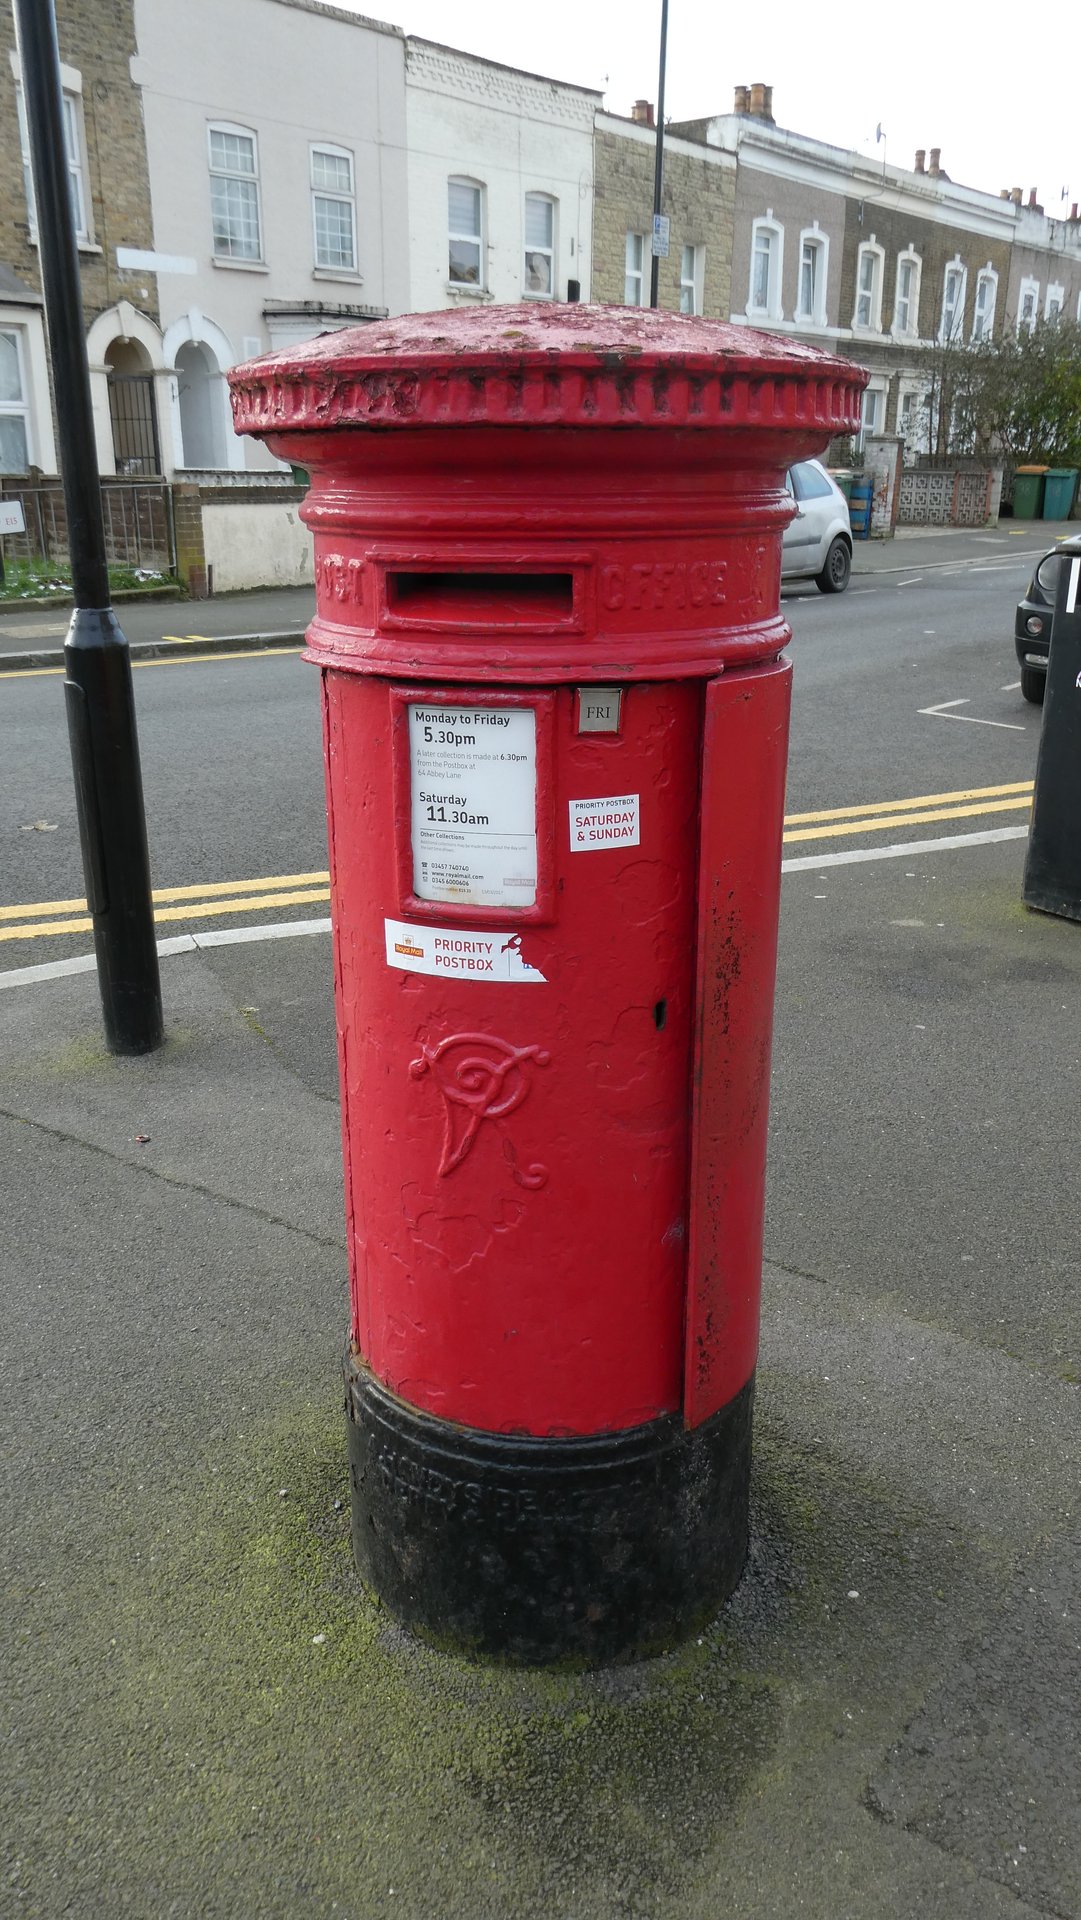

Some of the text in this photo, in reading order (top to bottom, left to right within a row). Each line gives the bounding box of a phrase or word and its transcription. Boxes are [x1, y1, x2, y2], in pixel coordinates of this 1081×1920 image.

[5, 517, 17, 525] E15
[586, 706, 610, 719] FRI
[415, 711, 510, 727] Monday to Friday
[424, 726, 476, 747] 5.30pm
[437, 751, 465, 759] collection
[473, 753, 491, 761] made
[500, 753, 528, 762] 6.30pm
[417, 759, 431, 767] from
[433, 760, 442, 768] the
[443, 760, 468, 769] Postbox
[427, 770, 445, 779] Abbey
[446, 771, 461, 779] Lane
[419, 791, 467, 808] Saturday
[575, 798, 635, 810] PRIORITY POSTBOX
[426, 805, 489, 825] 11.30am
[575, 812, 635, 827] SATURDAY
[436, 832, 465, 841] Collections
[577, 826, 635, 841] & SUNDAY
[449, 864, 470, 872] 740740
[431, 871, 484, 880] www.royalmail.com
[446, 878, 470, 886] 6000606
[396, 944, 423, 956] Royal Mail
[434, 938, 493, 954] PRIORITY
[435, 955, 494, 971] POSTBOX
